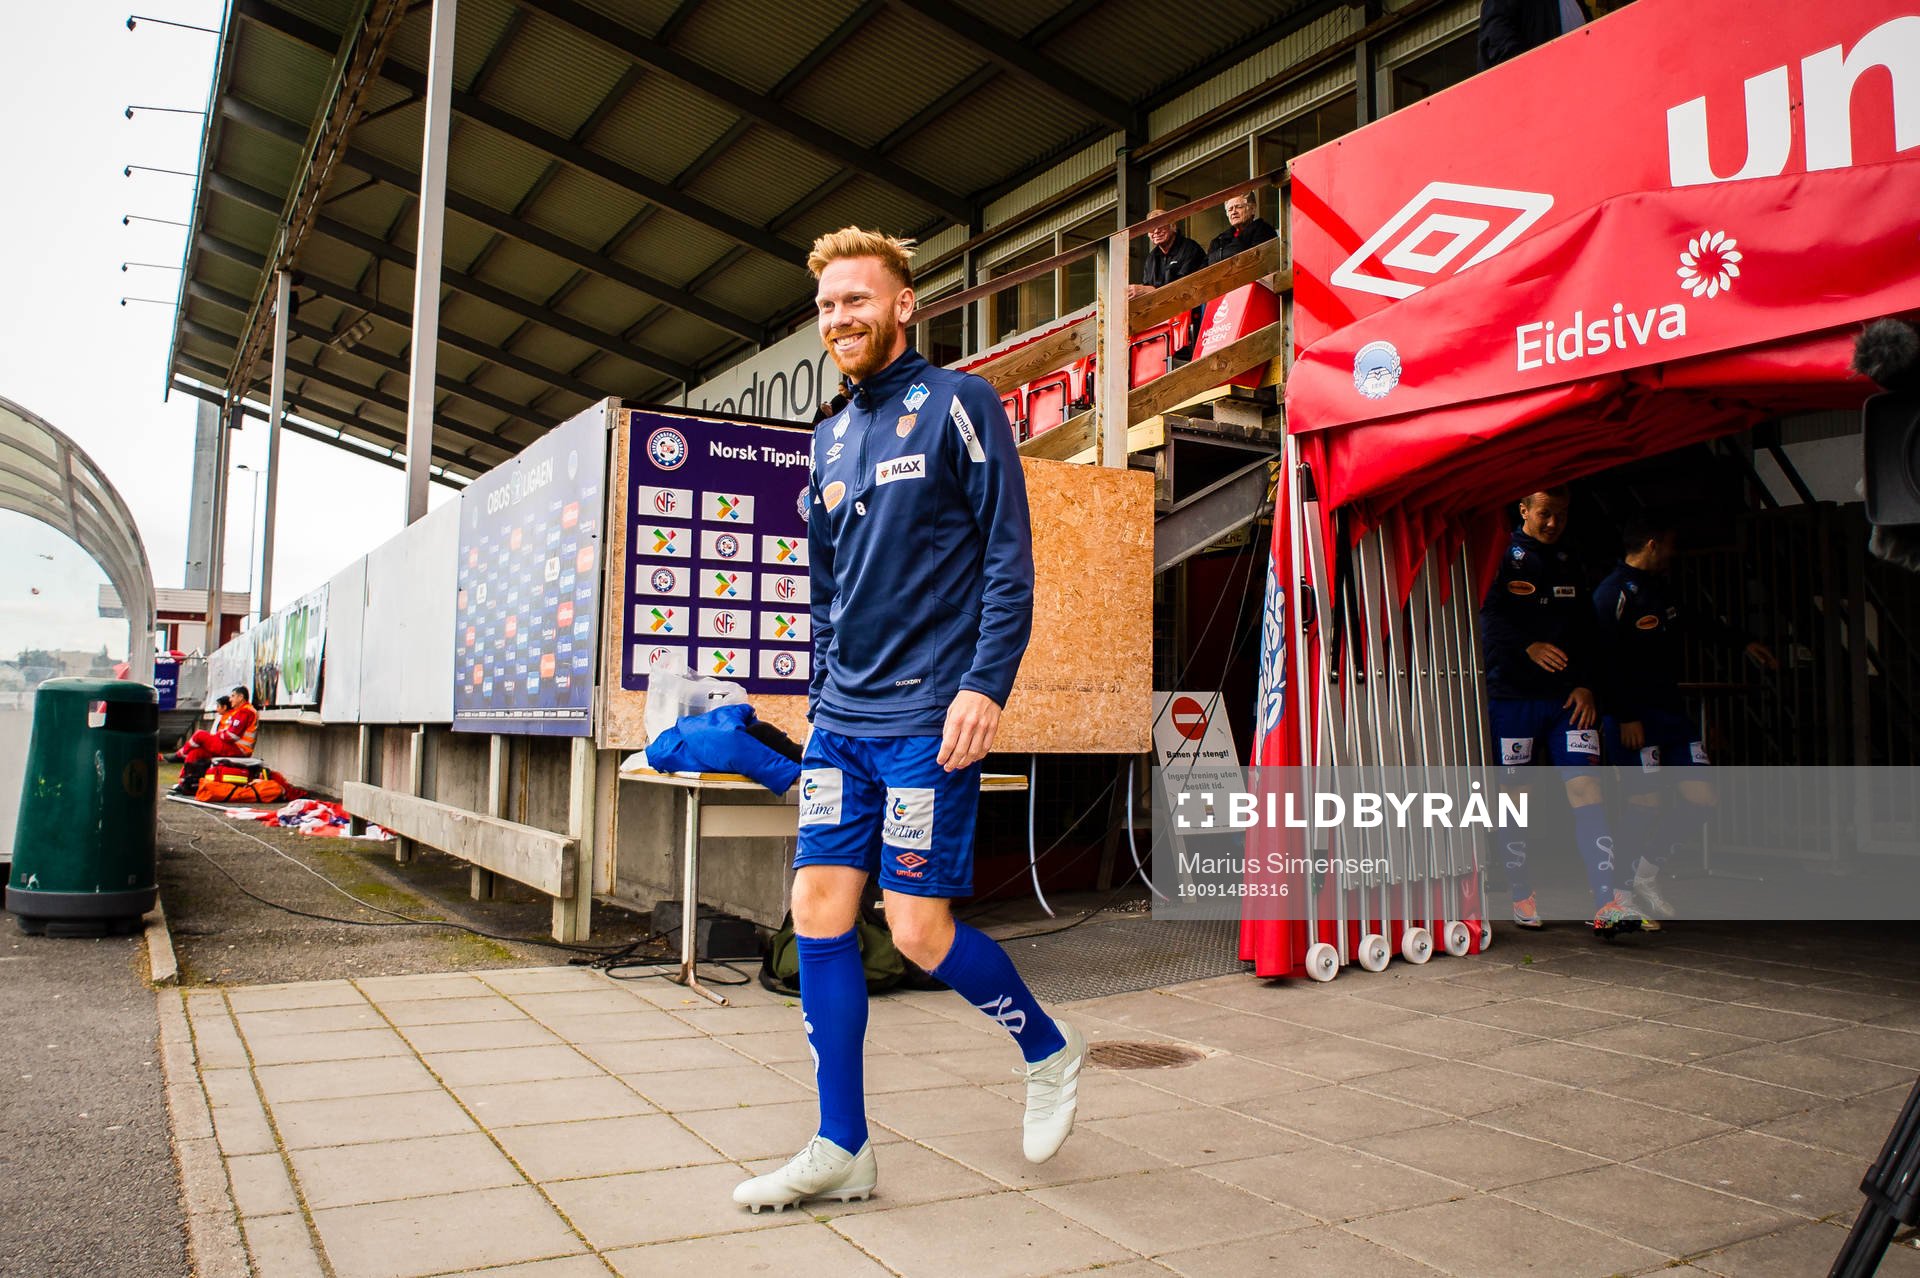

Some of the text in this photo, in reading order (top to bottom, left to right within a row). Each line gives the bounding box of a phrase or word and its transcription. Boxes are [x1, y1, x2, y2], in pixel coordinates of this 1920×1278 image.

[1516, 302, 1687, 372] Eidsiva
[954, 411, 973, 442] umbro
[709, 440, 757, 461] Norsk
[761, 446, 810, 468] Tippin
[892, 460, 921, 475] MAX
[487, 456, 553, 515] OBOS LIGAEN
[855, 502, 867, 516] 8
[154, 678, 175, 686] Kors
[1202, 749, 1229, 759] stengt!
[1191, 771, 1219, 781] trening
[1220, 770, 1238, 779] uten
[1212, 781, 1225, 790] tid.
[896, 869, 923, 878] umbro
